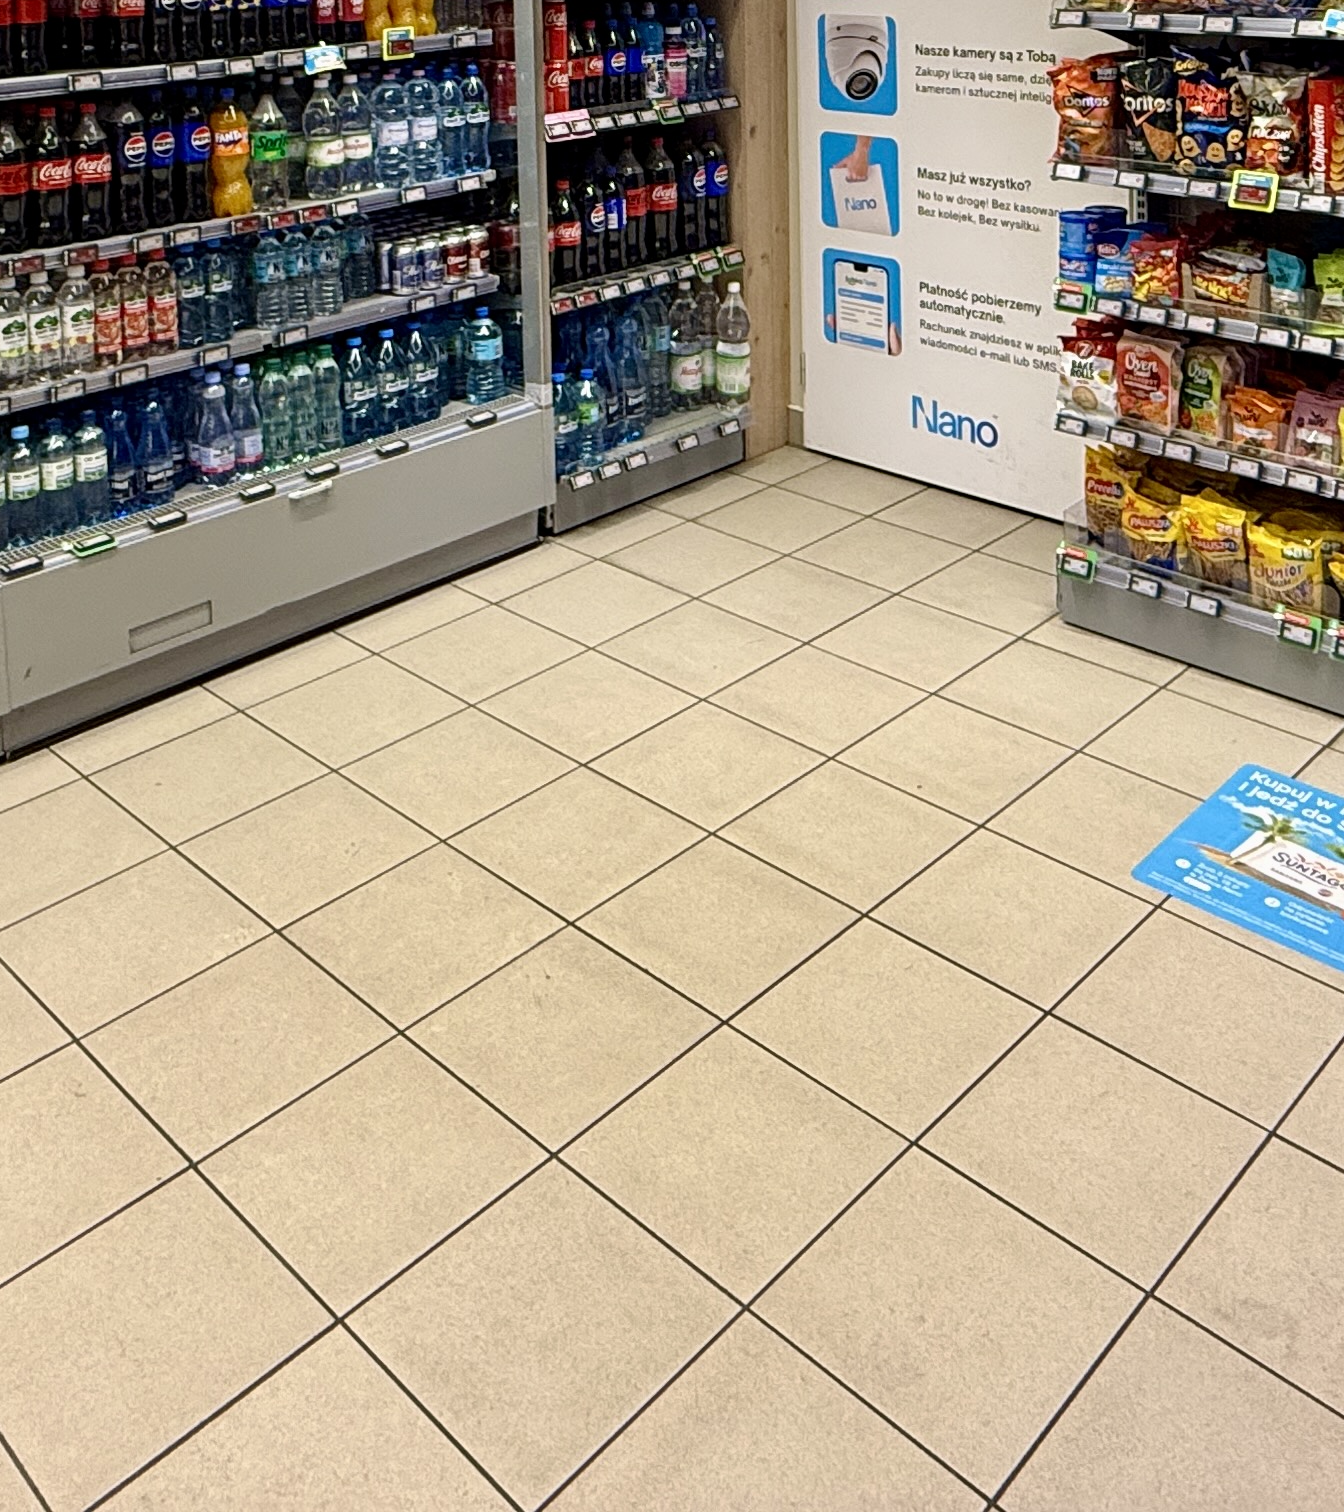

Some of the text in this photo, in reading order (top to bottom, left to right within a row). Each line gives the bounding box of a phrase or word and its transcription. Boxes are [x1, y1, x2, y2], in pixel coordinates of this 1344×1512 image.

[915, 43, 1056, 65] Nasze kamery są z Tobą
[915, 66, 950, 80] Zakupy
[953, 69, 975, 81] liczą
[978, 70, 993, 82] się
[915, 83, 961, 95] kamerom
[968, 87, 1017, 102] sztucznej
[917, 167, 1031, 192] Masz już wszystko?
[844, 197, 877, 212] Nano
[917, 190, 931, 201] No
[933, 192, 943, 203] to
[946, 195, 955, 204] w
[957, 194, 989, 210] drogę!
[992, 199, 1011, 212] Bez
[917, 206, 936, 217] Bez
[979, 215, 998, 227] Bez
[919, 281, 1042, 316] Płatność pobierzemy
[919, 298, 1006, 324] automatycznie.
[919, 318, 967, 338] Rachunek
[969, 329, 1022, 350] znajdziesz
[1025, 342, 1034, 351] w
[919, 335, 978, 356] wiadomości
[980, 348, 1011, 364] e-mail
[1013, 356, 1030, 368] lub
[912, 395, 998, 448] Nano
[1248, 771, 1313, 803] Kupuj
[1315, 795, 1338, 810] w
[1246, 785, 1298, 813] jedź
[1301, 804, 1332, 825] do
